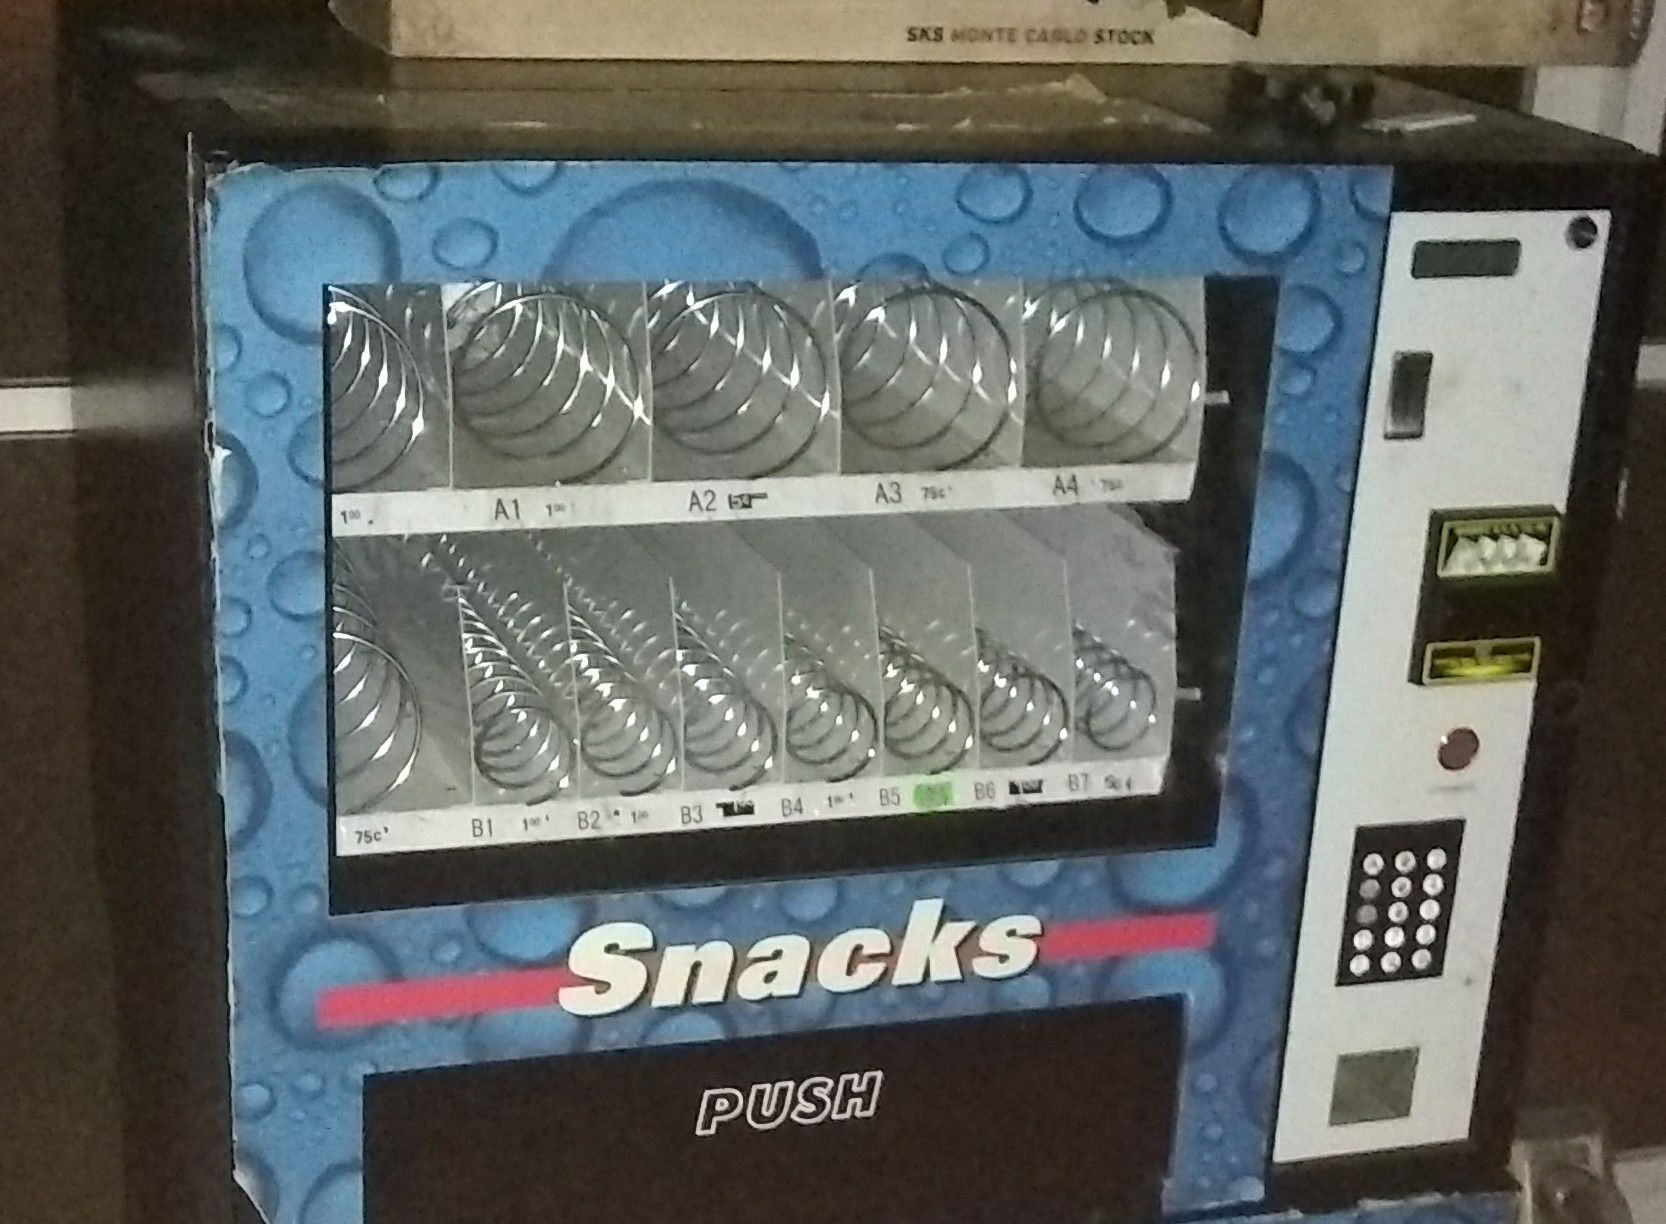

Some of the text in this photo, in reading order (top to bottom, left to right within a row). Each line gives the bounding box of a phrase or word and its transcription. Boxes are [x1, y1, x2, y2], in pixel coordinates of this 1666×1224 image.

[1094, 28, 1155, 46] STOCK
[494, 497, 521, 521] A1
[688, 489, 717, 512] A2
[874, 480, 902, 504] A3
[1053, 474, 1079, 496] A4
[471, 818, 493, 838] B1
[577, 810, 601, 830] B2
[680, 804, 704, 825] B3
[781, 797, 804, 818] B4
[879, 786, 901, 807] B5
[973, 780, 997, 801] B6
[1068, 772, 1089, 792] B7
[557, 897, 1044, 1018] Snacks
[695, 1069, 884, 1137] PUSH
